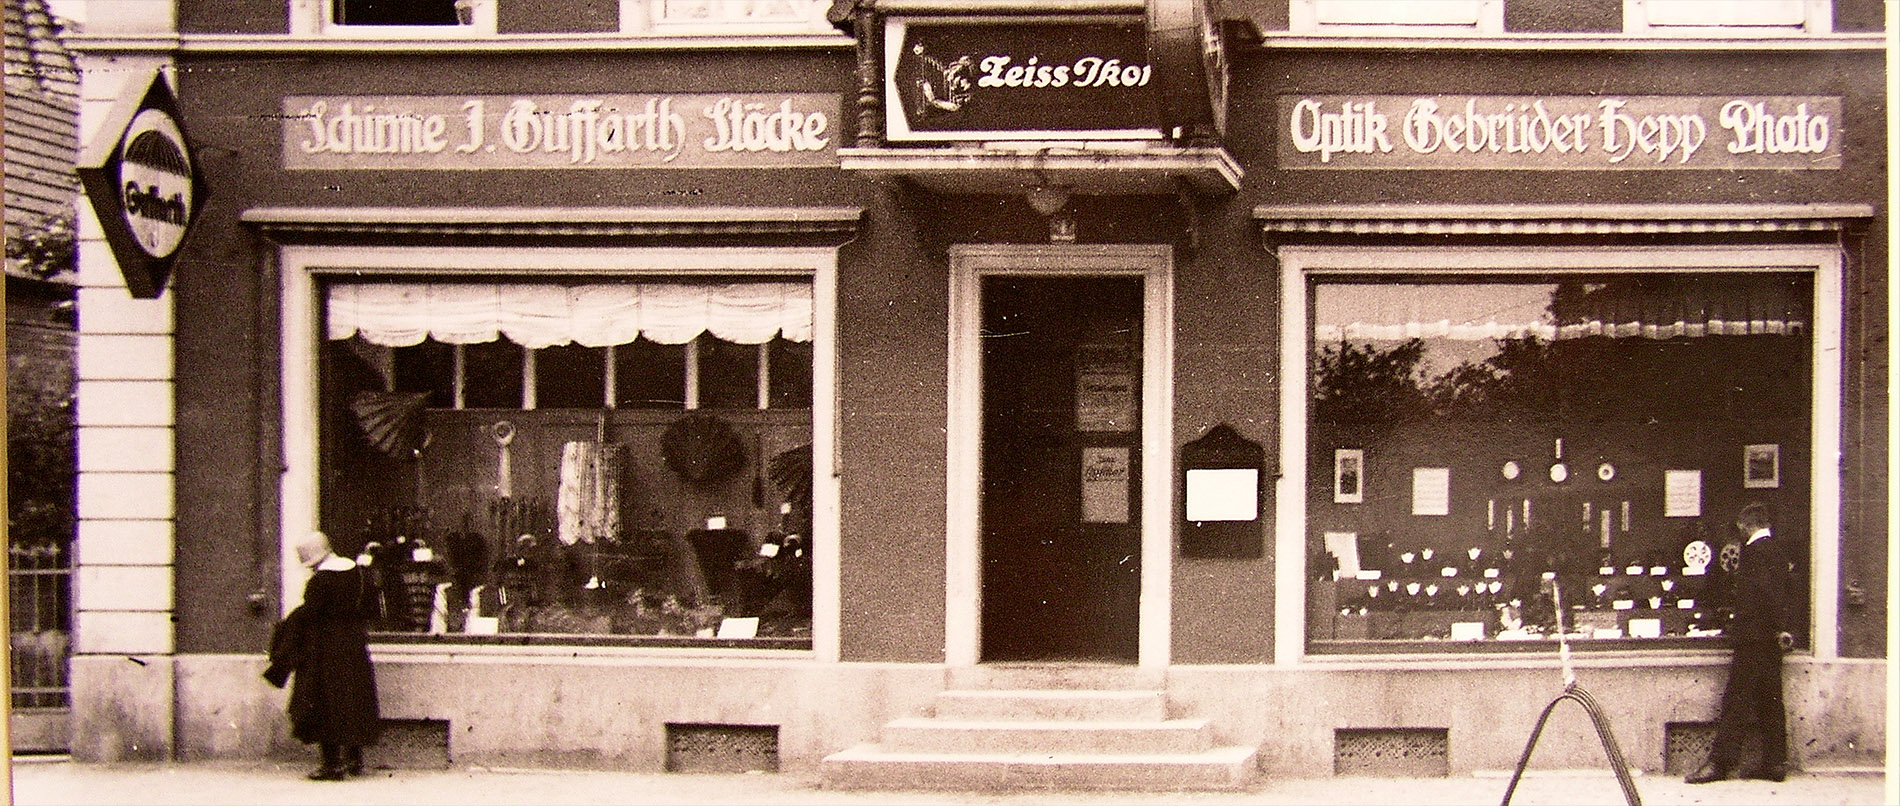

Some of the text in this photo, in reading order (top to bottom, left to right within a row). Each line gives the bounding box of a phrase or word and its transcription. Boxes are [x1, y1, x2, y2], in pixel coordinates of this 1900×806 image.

[977, 55, 1069, 88] Zeiss
[301, 100, 449, 153] Schirme
[501, 98, 686, 164] Guffarth
[703, 97, 831, 152] Stöcke
[1290, 97, 1831, 164] Optik Gebrüder Hepp Photo
